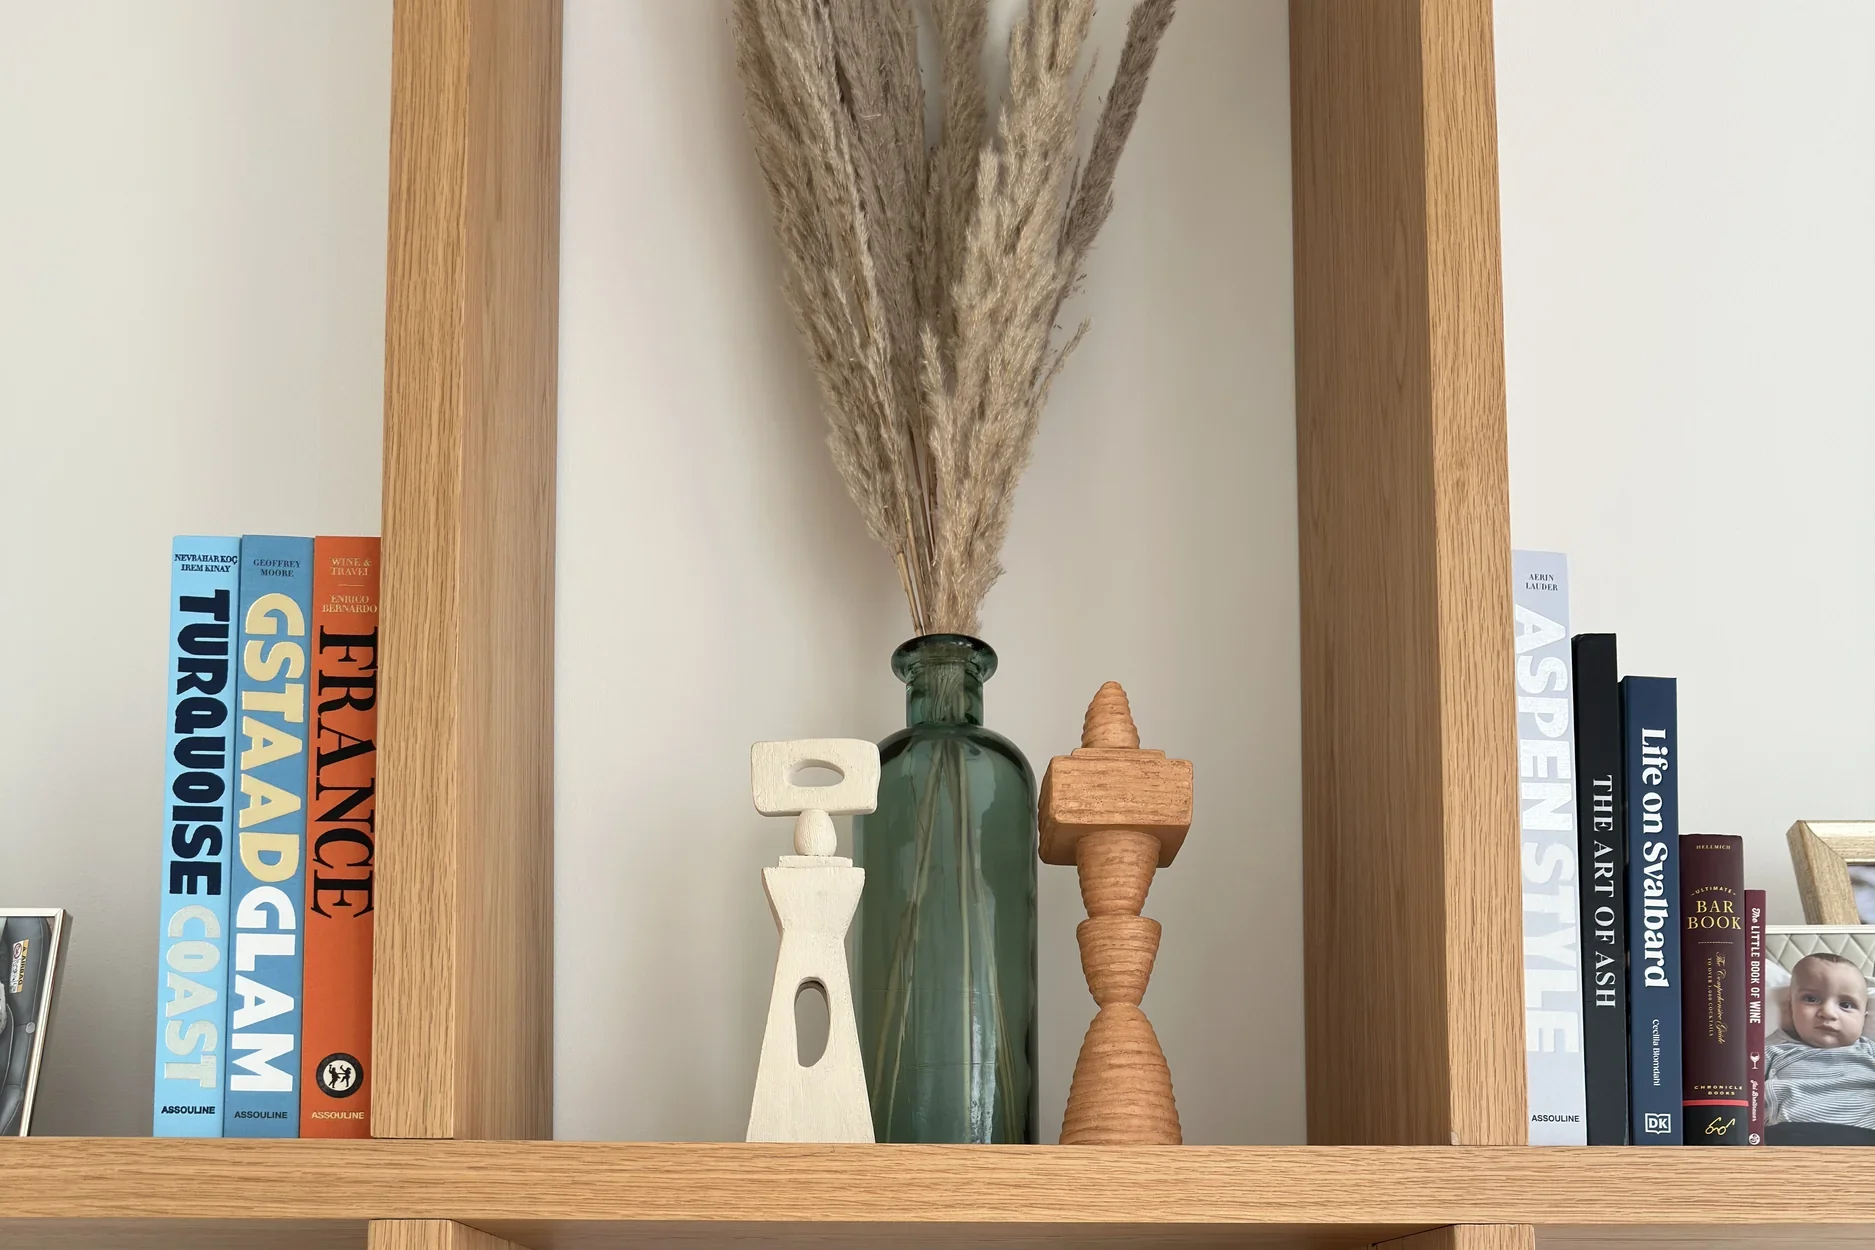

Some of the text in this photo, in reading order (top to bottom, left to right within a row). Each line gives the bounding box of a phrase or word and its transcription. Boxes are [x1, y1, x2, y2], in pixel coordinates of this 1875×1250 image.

[253, 558, 301, 568] GEOFFREY
[330, 557, 372, 567] WINE &
[260, 568, 294, 577] MOORE
[330, 567, 369, 576] TRAVEL
[1528, 573, 1555, 581] AERIN
[1525, 582, 1559, 591] LAUDER
[331, 595, 370, 604] ENRICO
[321, 604, 378, 613] BERNARDO
[311, 624, 378, 919] FRANCE
[163, 588, 230, 1089] TURQUOISE COAST
[1642, 728, 1670, 988] Life on Svalbard
[1593, 774, 1616, 1008] THE ART OF ASH
[1695, 886, 1732, 894] ULTIMATE
[1696, 900, 1734, 913] BAR
[1687, 916, 1741, 930] BOOK
[1749, 907, 1761, 1024] The LITTLE BOOK OF WINE
[1714, 969, 1727, 1020] Comprehensive
[1715, 1021, 1728, 1045] Guide
[1652, 1019, 1660, 1086] Cecilia Blomdahl
[161, 1105, 216, 1115] ASSOULINE
[234, 1110, 288, 1120] ASSOULINE
[311, 1111, 365, 1120] ASSOULINE
[1531, 1114, 1580, 1123] ASSOULINE
[1648, 1117, 1669, 1130] DK
